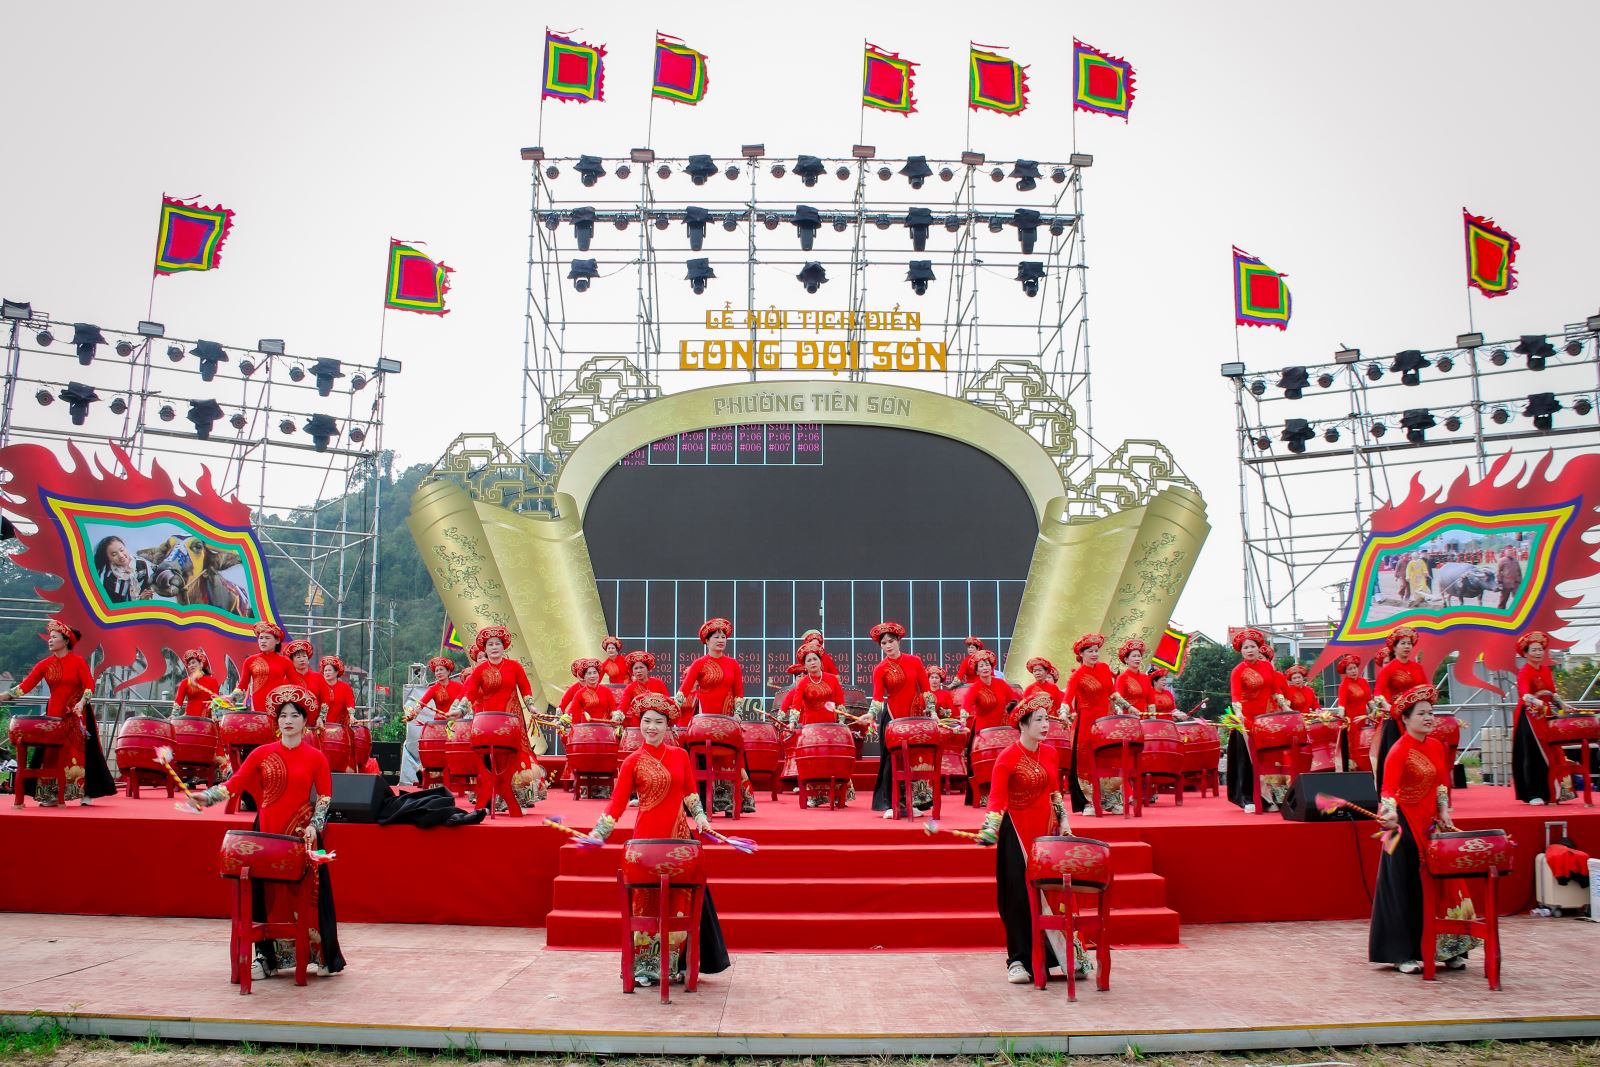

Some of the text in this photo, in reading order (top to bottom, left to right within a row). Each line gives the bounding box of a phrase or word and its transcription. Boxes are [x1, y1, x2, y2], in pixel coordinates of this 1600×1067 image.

[798, 309, 856, 335] TỊCH
[680, 337, 947, 377] LONG ĐỌI SƠN
[713, 390, 911, 417] PHƯỜNG TIÊN SƠN
[739, 432, 762, 441] P:06
[768, 432, 791, 441] P:06
[797, 432, 820, 441] P:06
[652, 442, 820, 452] #003 #004 #005 #006 #007 #008
[738, 652, 761, 662] S:01
[767, 652, 790, 662] S:01
[856, 652, 879, 662] S:01
